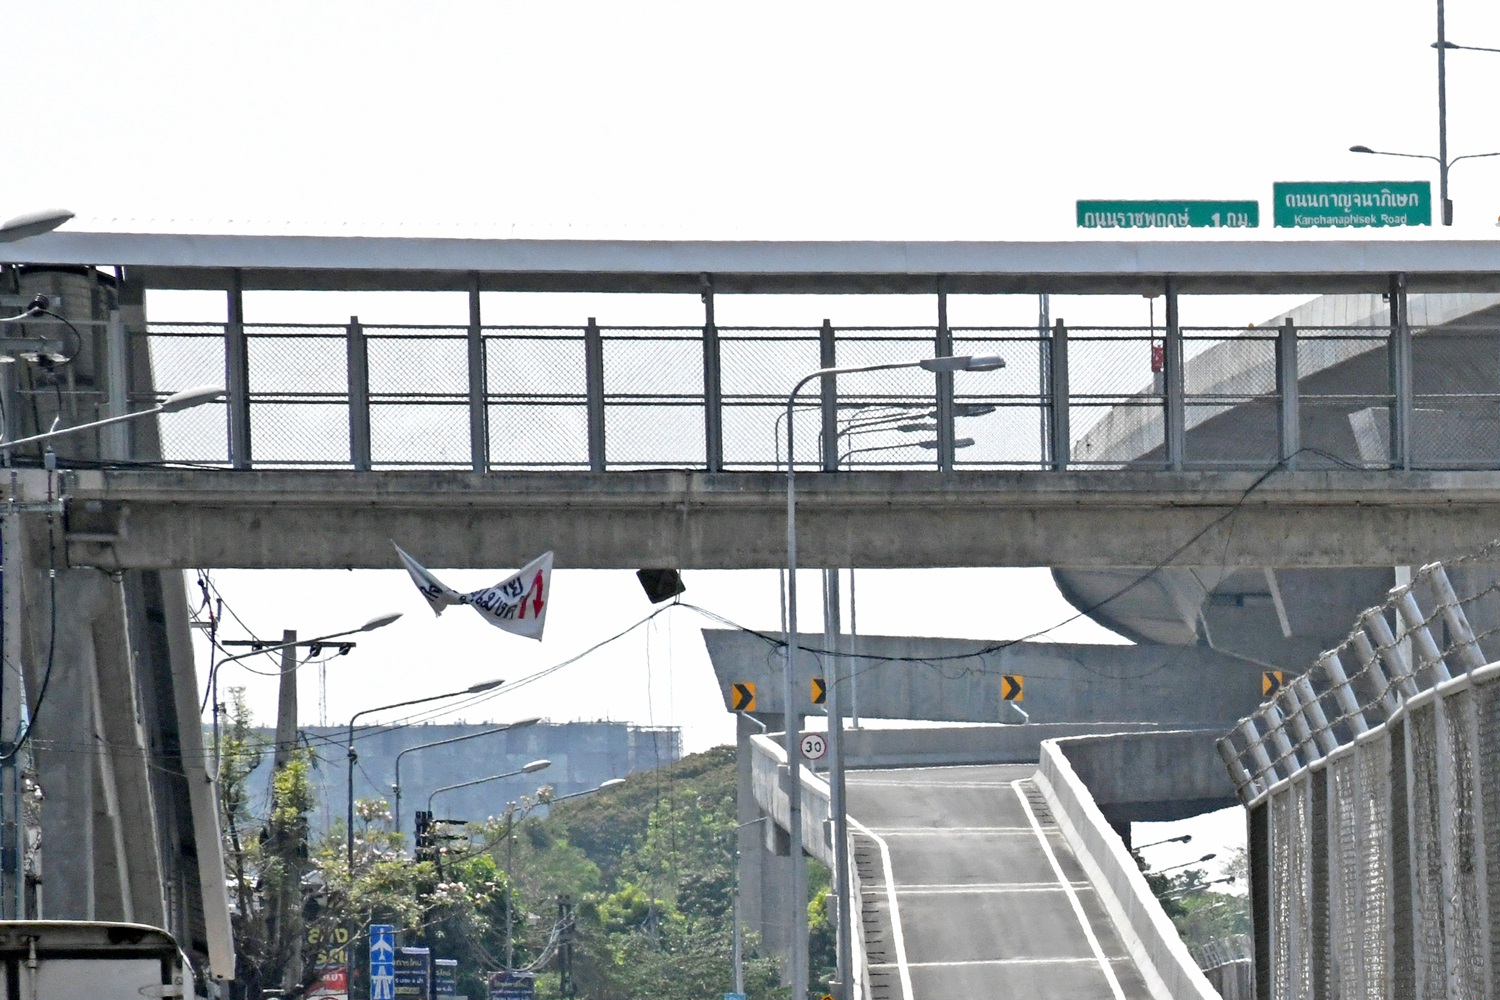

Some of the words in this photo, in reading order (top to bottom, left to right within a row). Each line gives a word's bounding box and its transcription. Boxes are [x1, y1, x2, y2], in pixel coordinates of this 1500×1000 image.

[1285, 188, 1419, 213] ถนนกาญจนาภิเษก
[1211, 212, 1221, 227] 1
[1294, 214, 1377, 225] Kanchanaphisek
[1380, 214, 1408, 225] Road
[805, 741, 822, 752] 30
